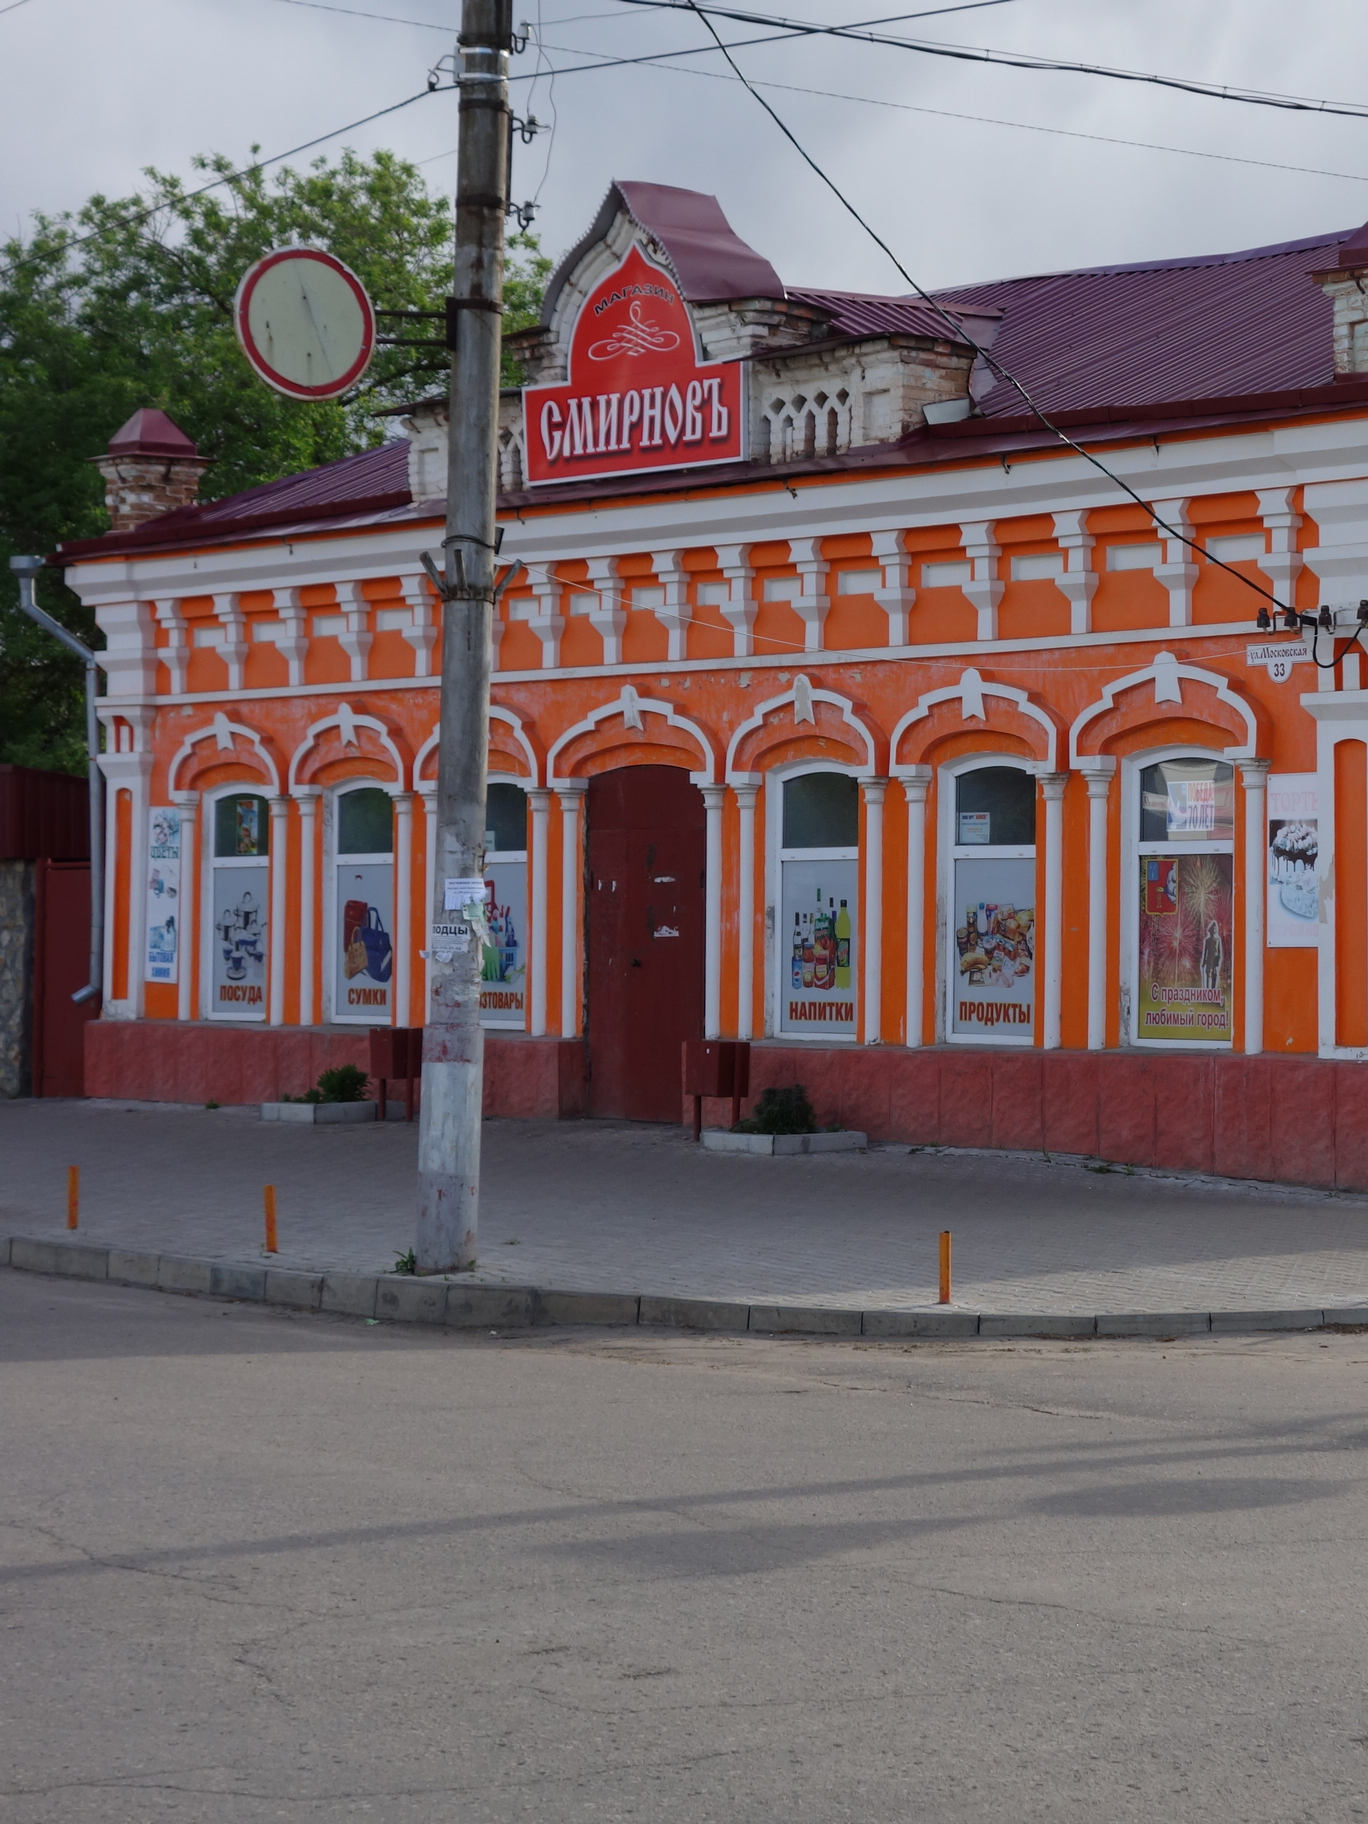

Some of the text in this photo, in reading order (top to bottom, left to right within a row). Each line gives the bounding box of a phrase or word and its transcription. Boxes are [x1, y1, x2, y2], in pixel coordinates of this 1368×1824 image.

[594, 284, 675, 317] МАГАЗИН
[540, 377, 728, 460] СМИРНОВЪ
[1273, 663, 1286, 677] 33
[220, 985, 262, 1004] ПОСУДА
[347, 988, 386, 1005] СУМКИ
[1151, 984, 1225, 1005] С праздником,
[789, 1001, 854, 1022] НАПИТКИ
[958, 1001, 1031, 1026] ПРОДУКТЫ
[1145, 1009, 1229, 1030] любимый город!
